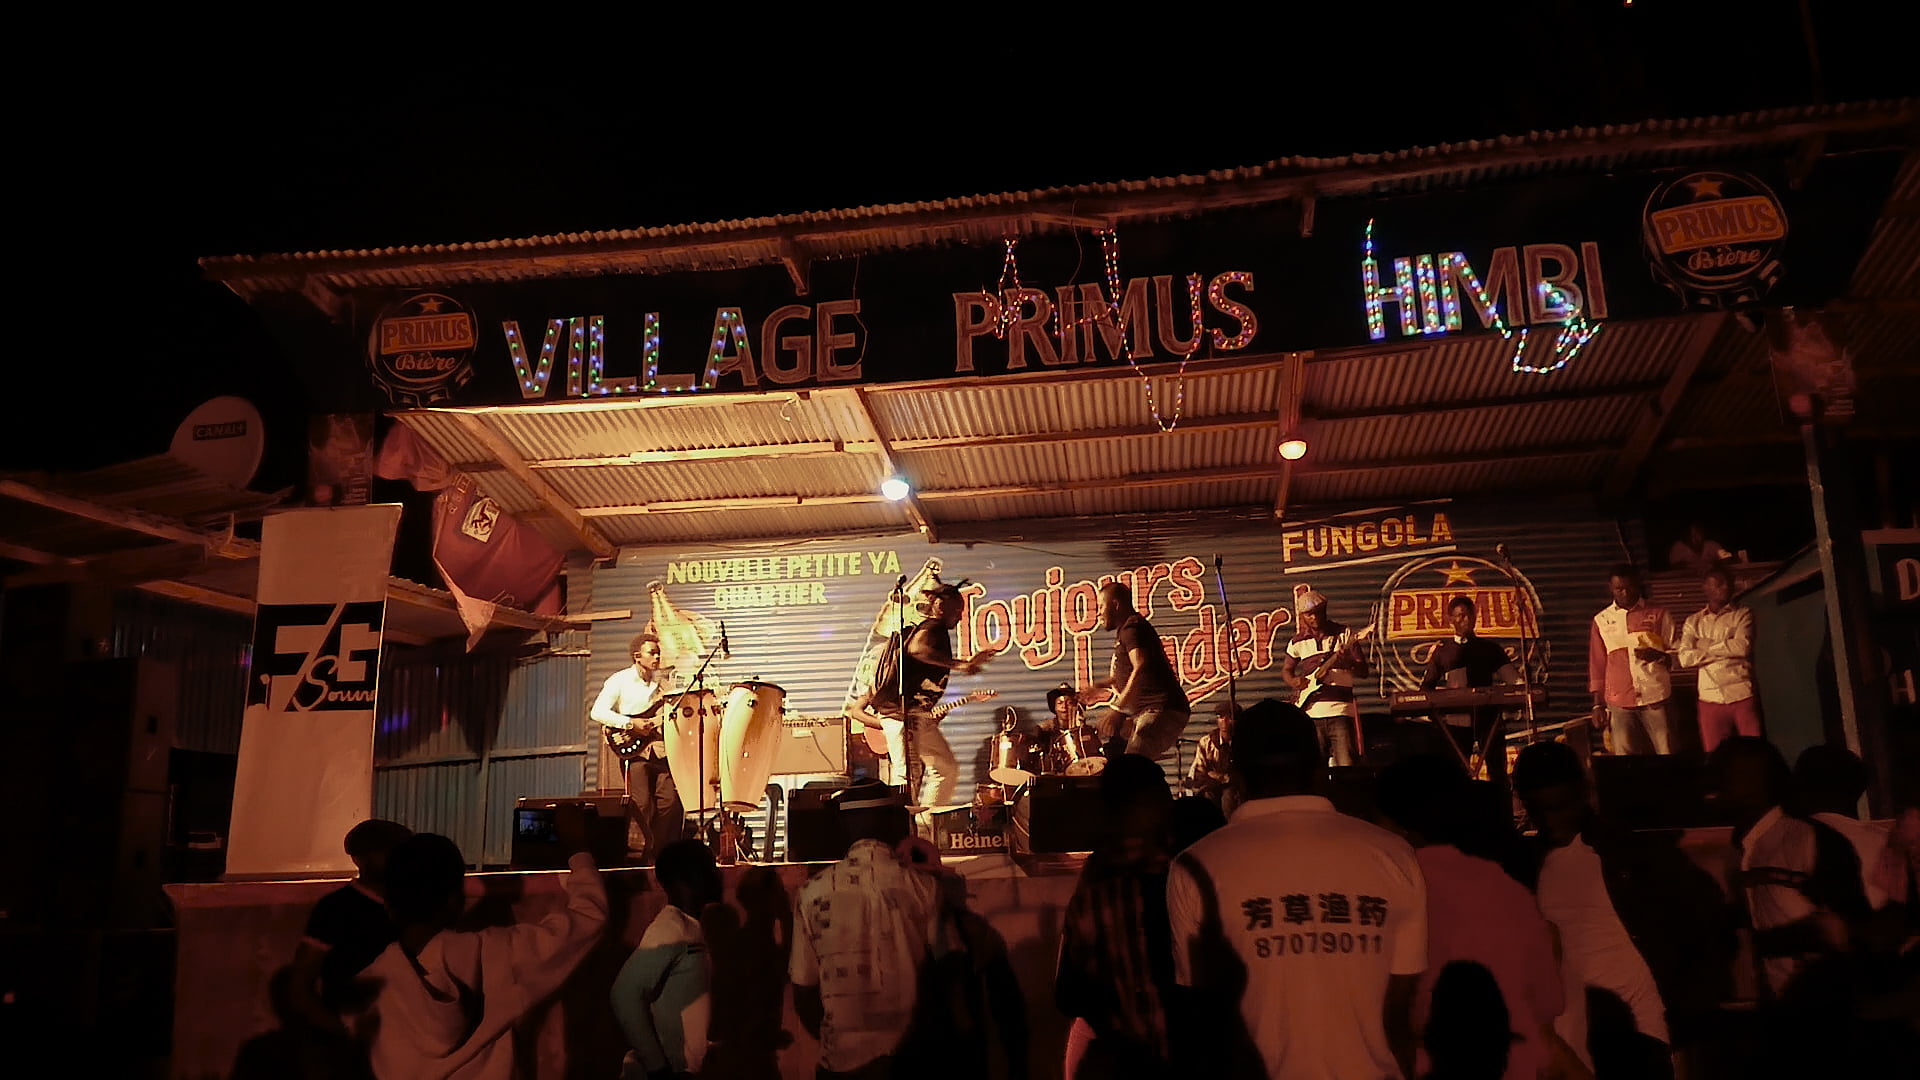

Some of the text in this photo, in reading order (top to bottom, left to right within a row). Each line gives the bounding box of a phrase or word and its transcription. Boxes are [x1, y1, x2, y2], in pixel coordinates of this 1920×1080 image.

[1658, 203, 1779, 247] PRIMUS
[383, 319, 469, 346] PRIMUS
[501, 241, 1608, 399] VILLAGE PRIMUS HIMBI
[395, 351, 456, 371] Bière
[1281, 512, 1453, 562] FUNGOLA
[667, 551, 900, 584] NOUVELLE PETITE YA
[1255, 932, 1382, 957] 87079011
